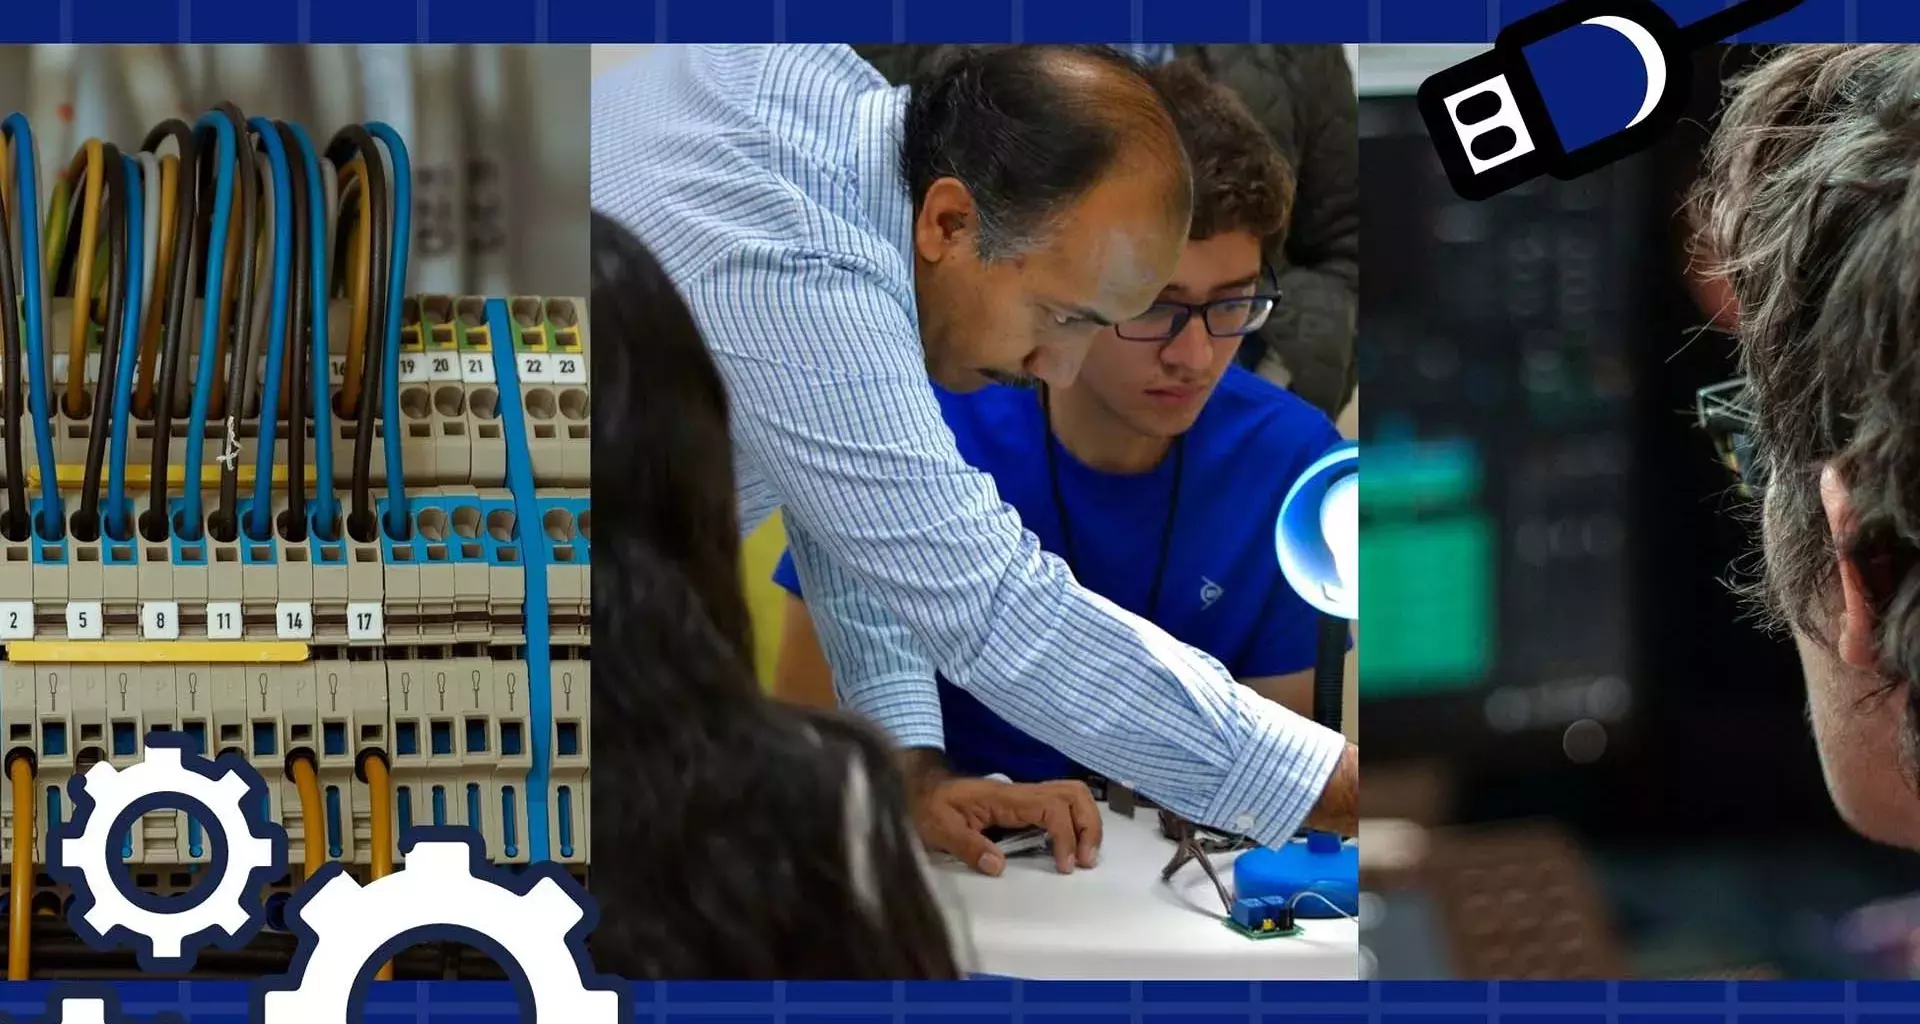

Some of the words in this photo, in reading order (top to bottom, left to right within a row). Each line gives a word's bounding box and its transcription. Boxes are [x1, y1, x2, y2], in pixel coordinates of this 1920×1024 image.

[400, 359, 415, 373] 19
[432, 358, 449, 372] 20
[468, 359, 483, 373] 21
[526, 359, 542, 373] 22
[559, 360, 576, 374] 23
[9, 611, 18, 629] 2
[78, 611, 87, 629] 5
[156, 612, 165, 629] 8
[217, 612, 231, 629] 11
[286, 612, 303, 630] 14
[356, 612, 373, 631] 17
